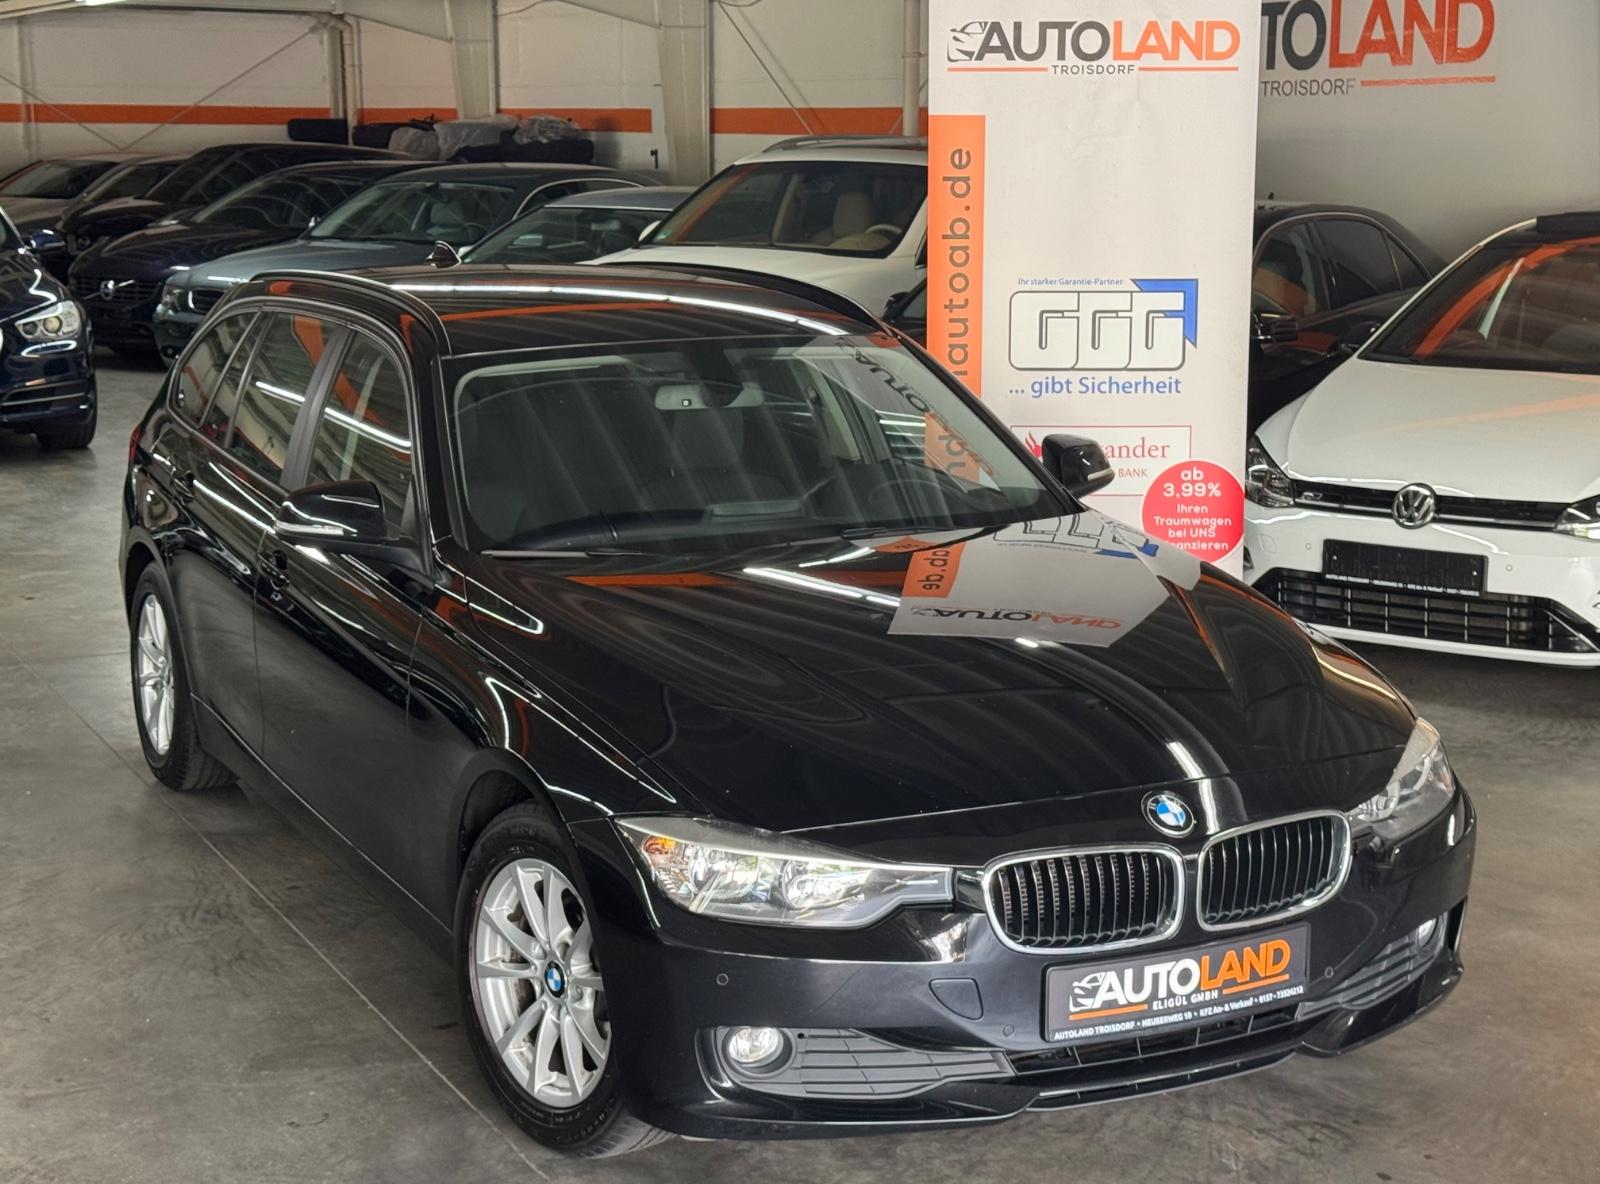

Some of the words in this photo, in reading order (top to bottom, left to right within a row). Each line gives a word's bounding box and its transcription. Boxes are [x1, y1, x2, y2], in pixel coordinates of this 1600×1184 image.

[974, 20, 1241, 62] AUTOLAND
[1051, 64, 1136, 75] TROISDORF
[1261, 78, 1356, 97] TROISDORF
[1018, 277, 1030, 286] Ihr
[1031, 277, 1057, 286] starker
[1058, 277, 1124, 287] Garantie-Partner
[1031, 376, 1073, 398] gibt
[1078, 376, 1182, 395] Sicherheit
[1102, 437, 1171, 459] ander
[1118, 467, 1149, 478] BANK
[1180, 466, 1204, 481] ab
[1176, 504, 1209, 513] Ihren
[1153, 515, 1232, 529] Traumwagen
[1168, 528, 1187, 538] bei
[1189, 528, 1217, 538] UNS
[1171, 541, 1229, 551] anzieren
[1091, 938, 1292, 1009] AUTOLAND
[1152, 994, 1188, 1011] ELIGÜL
[1190, 989, 1219, 1004] GMBH
[1054, 1026, 1095, 1040] AUTOLAND
[1096, 1020, 1136, 1035] TROISDORF
[1229, 997, 1254, 1010] Verkauf
